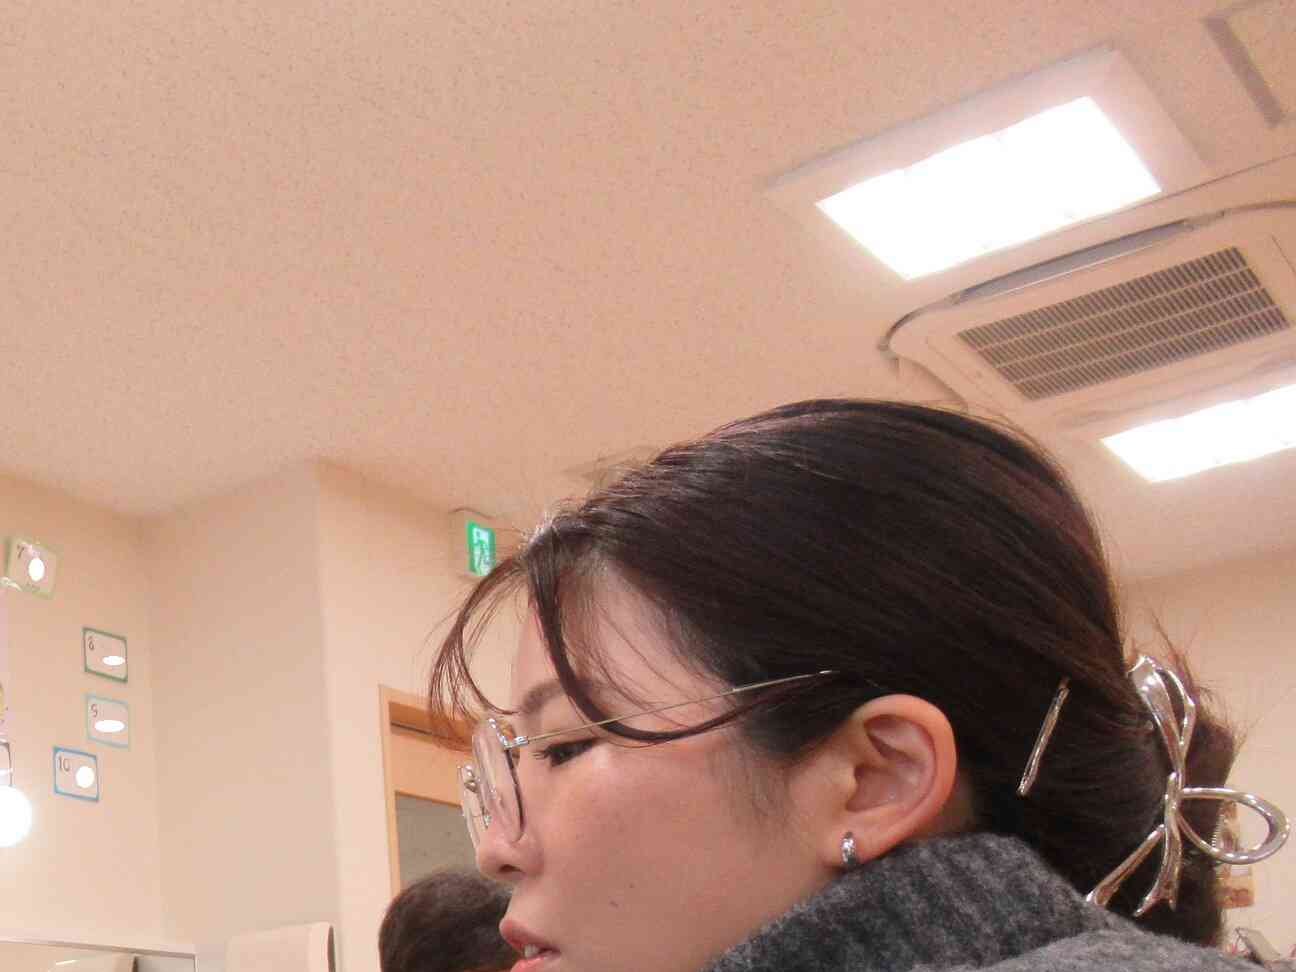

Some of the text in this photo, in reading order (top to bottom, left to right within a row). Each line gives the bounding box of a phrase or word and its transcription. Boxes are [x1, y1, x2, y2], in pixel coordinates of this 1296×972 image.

[16, 543, 25, 559] 7
[90, 703, 99, 717] 9
[58, 756, 71, 774] 10
